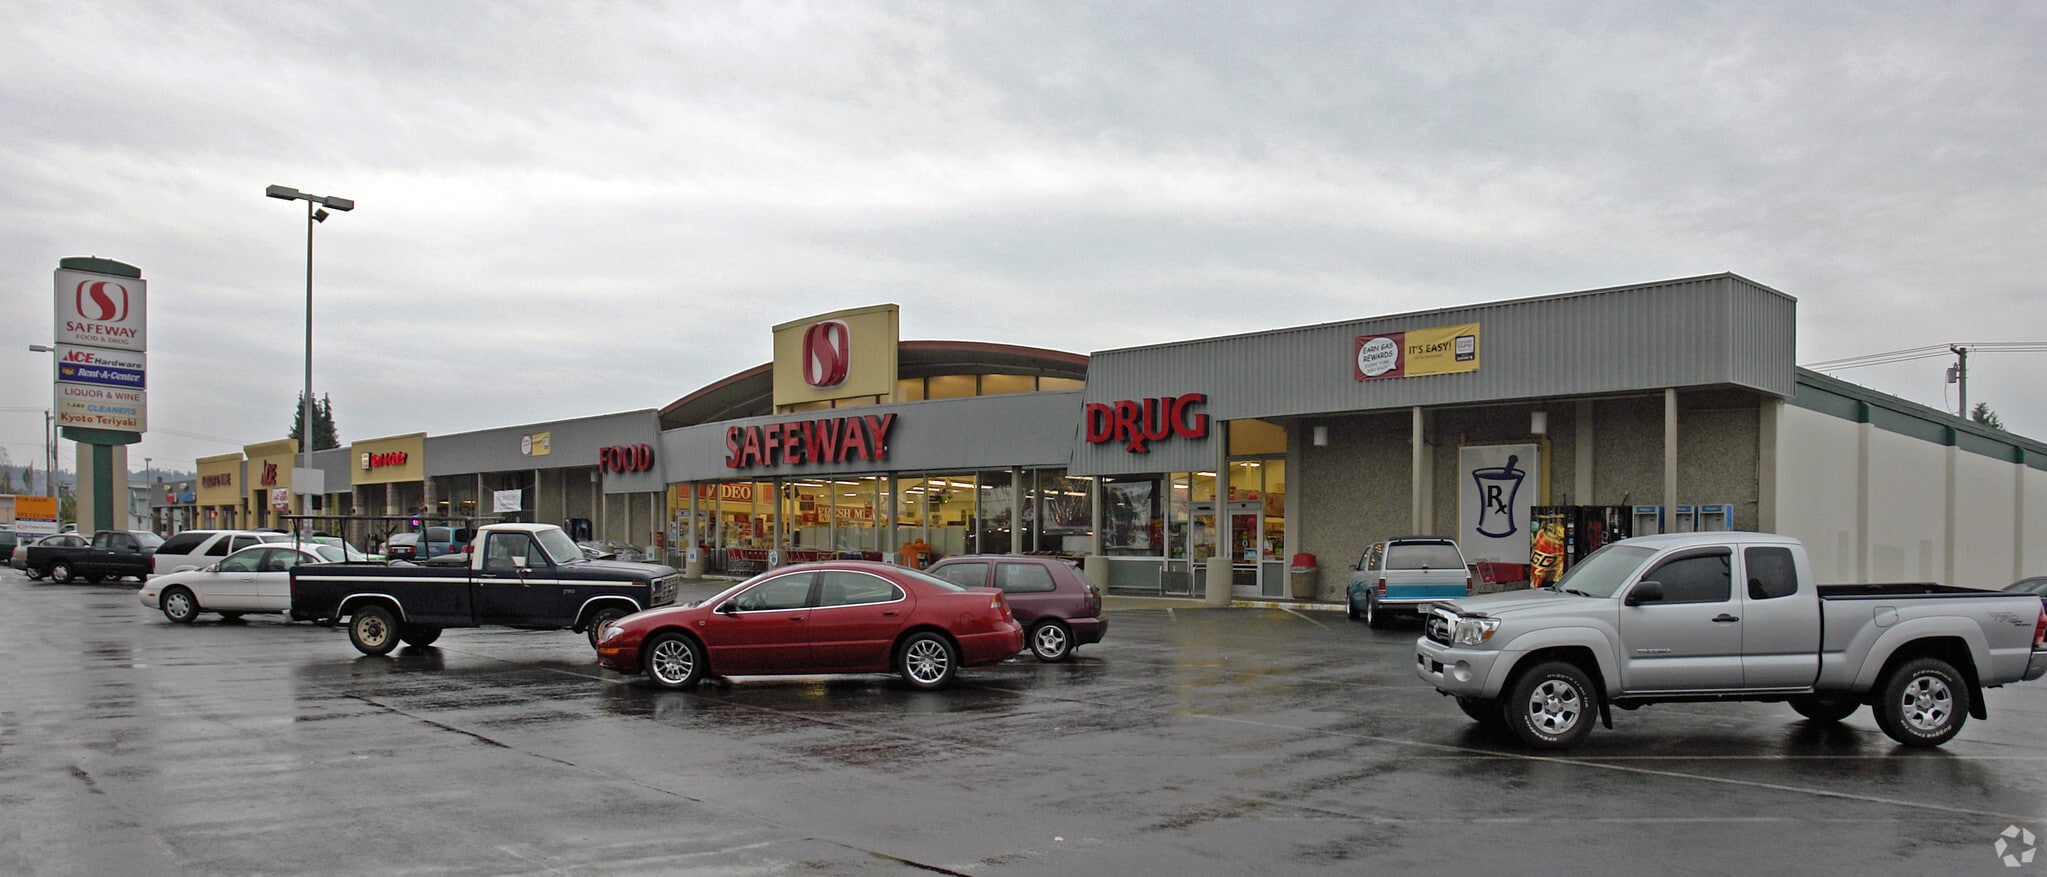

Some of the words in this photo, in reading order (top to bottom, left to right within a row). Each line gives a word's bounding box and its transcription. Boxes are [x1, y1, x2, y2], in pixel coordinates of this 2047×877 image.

[66, 321, 138, 338] SAFEWAY
[108, 337, 128, 345] DRUG
[1408, 344, 1423, 355] IT'S
[1425, 341, 1452, 353] EASY!
[1363, 344, 1380, 355] EARN
[1380, 342, 1393, 351] GAS
[62, 349, 95, 363] ACE
[94, 358, 142, 369] Hardware
[1363, 350, 1393, 363] REWARDS
[64, 388, 103, 398] LIQUOR
[106, 391, 113, 399] &
[115, 392, 140, 401] WINE
[87, 404, 137, 416] CLEANERS
[61, 412, 93, 424] Kyoto
[96, 415, 137, 427] Teriyaki
[1086, 393, 1209, 453] DRUG
[726, 413, 897, 469] SAFEWAY
[599, 443, 654, 474] FOOD
[708, 484, 752, 499] VDEO
[818, 506, 850, 519] FRSH
